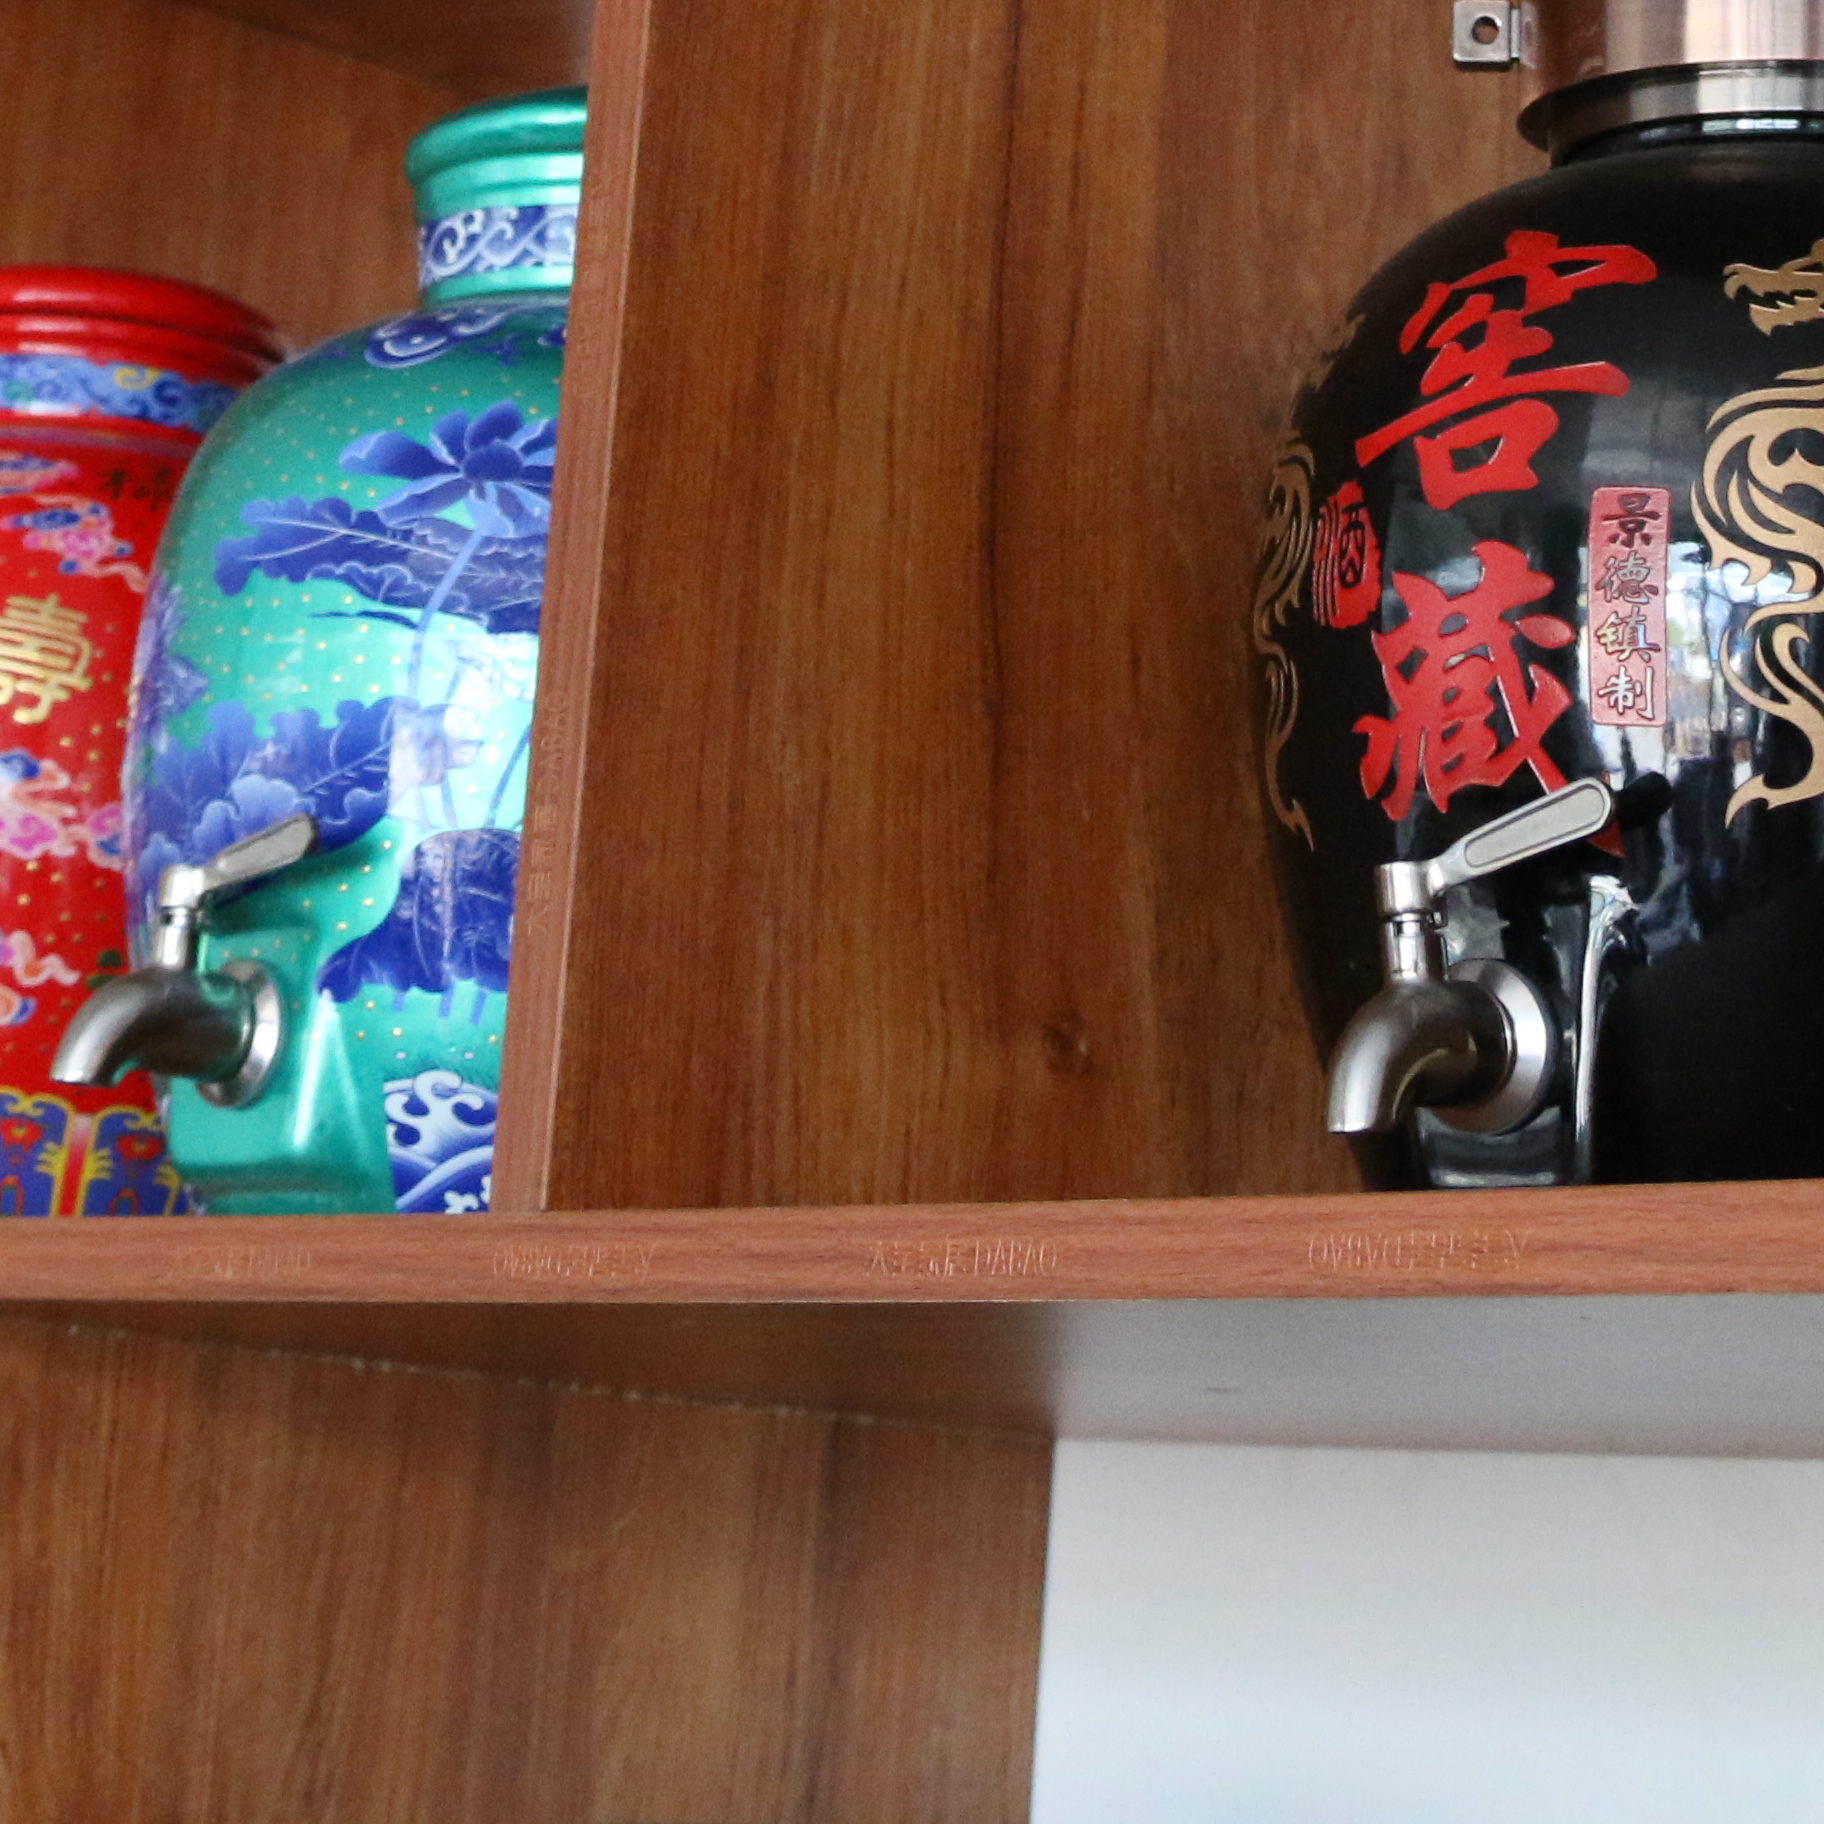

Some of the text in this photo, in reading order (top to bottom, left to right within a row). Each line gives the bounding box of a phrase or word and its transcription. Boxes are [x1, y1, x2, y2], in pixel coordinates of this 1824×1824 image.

[1356, 230, 1658, 856] 窖藏
[1594, 492, 1662, 721] 景德镇制
